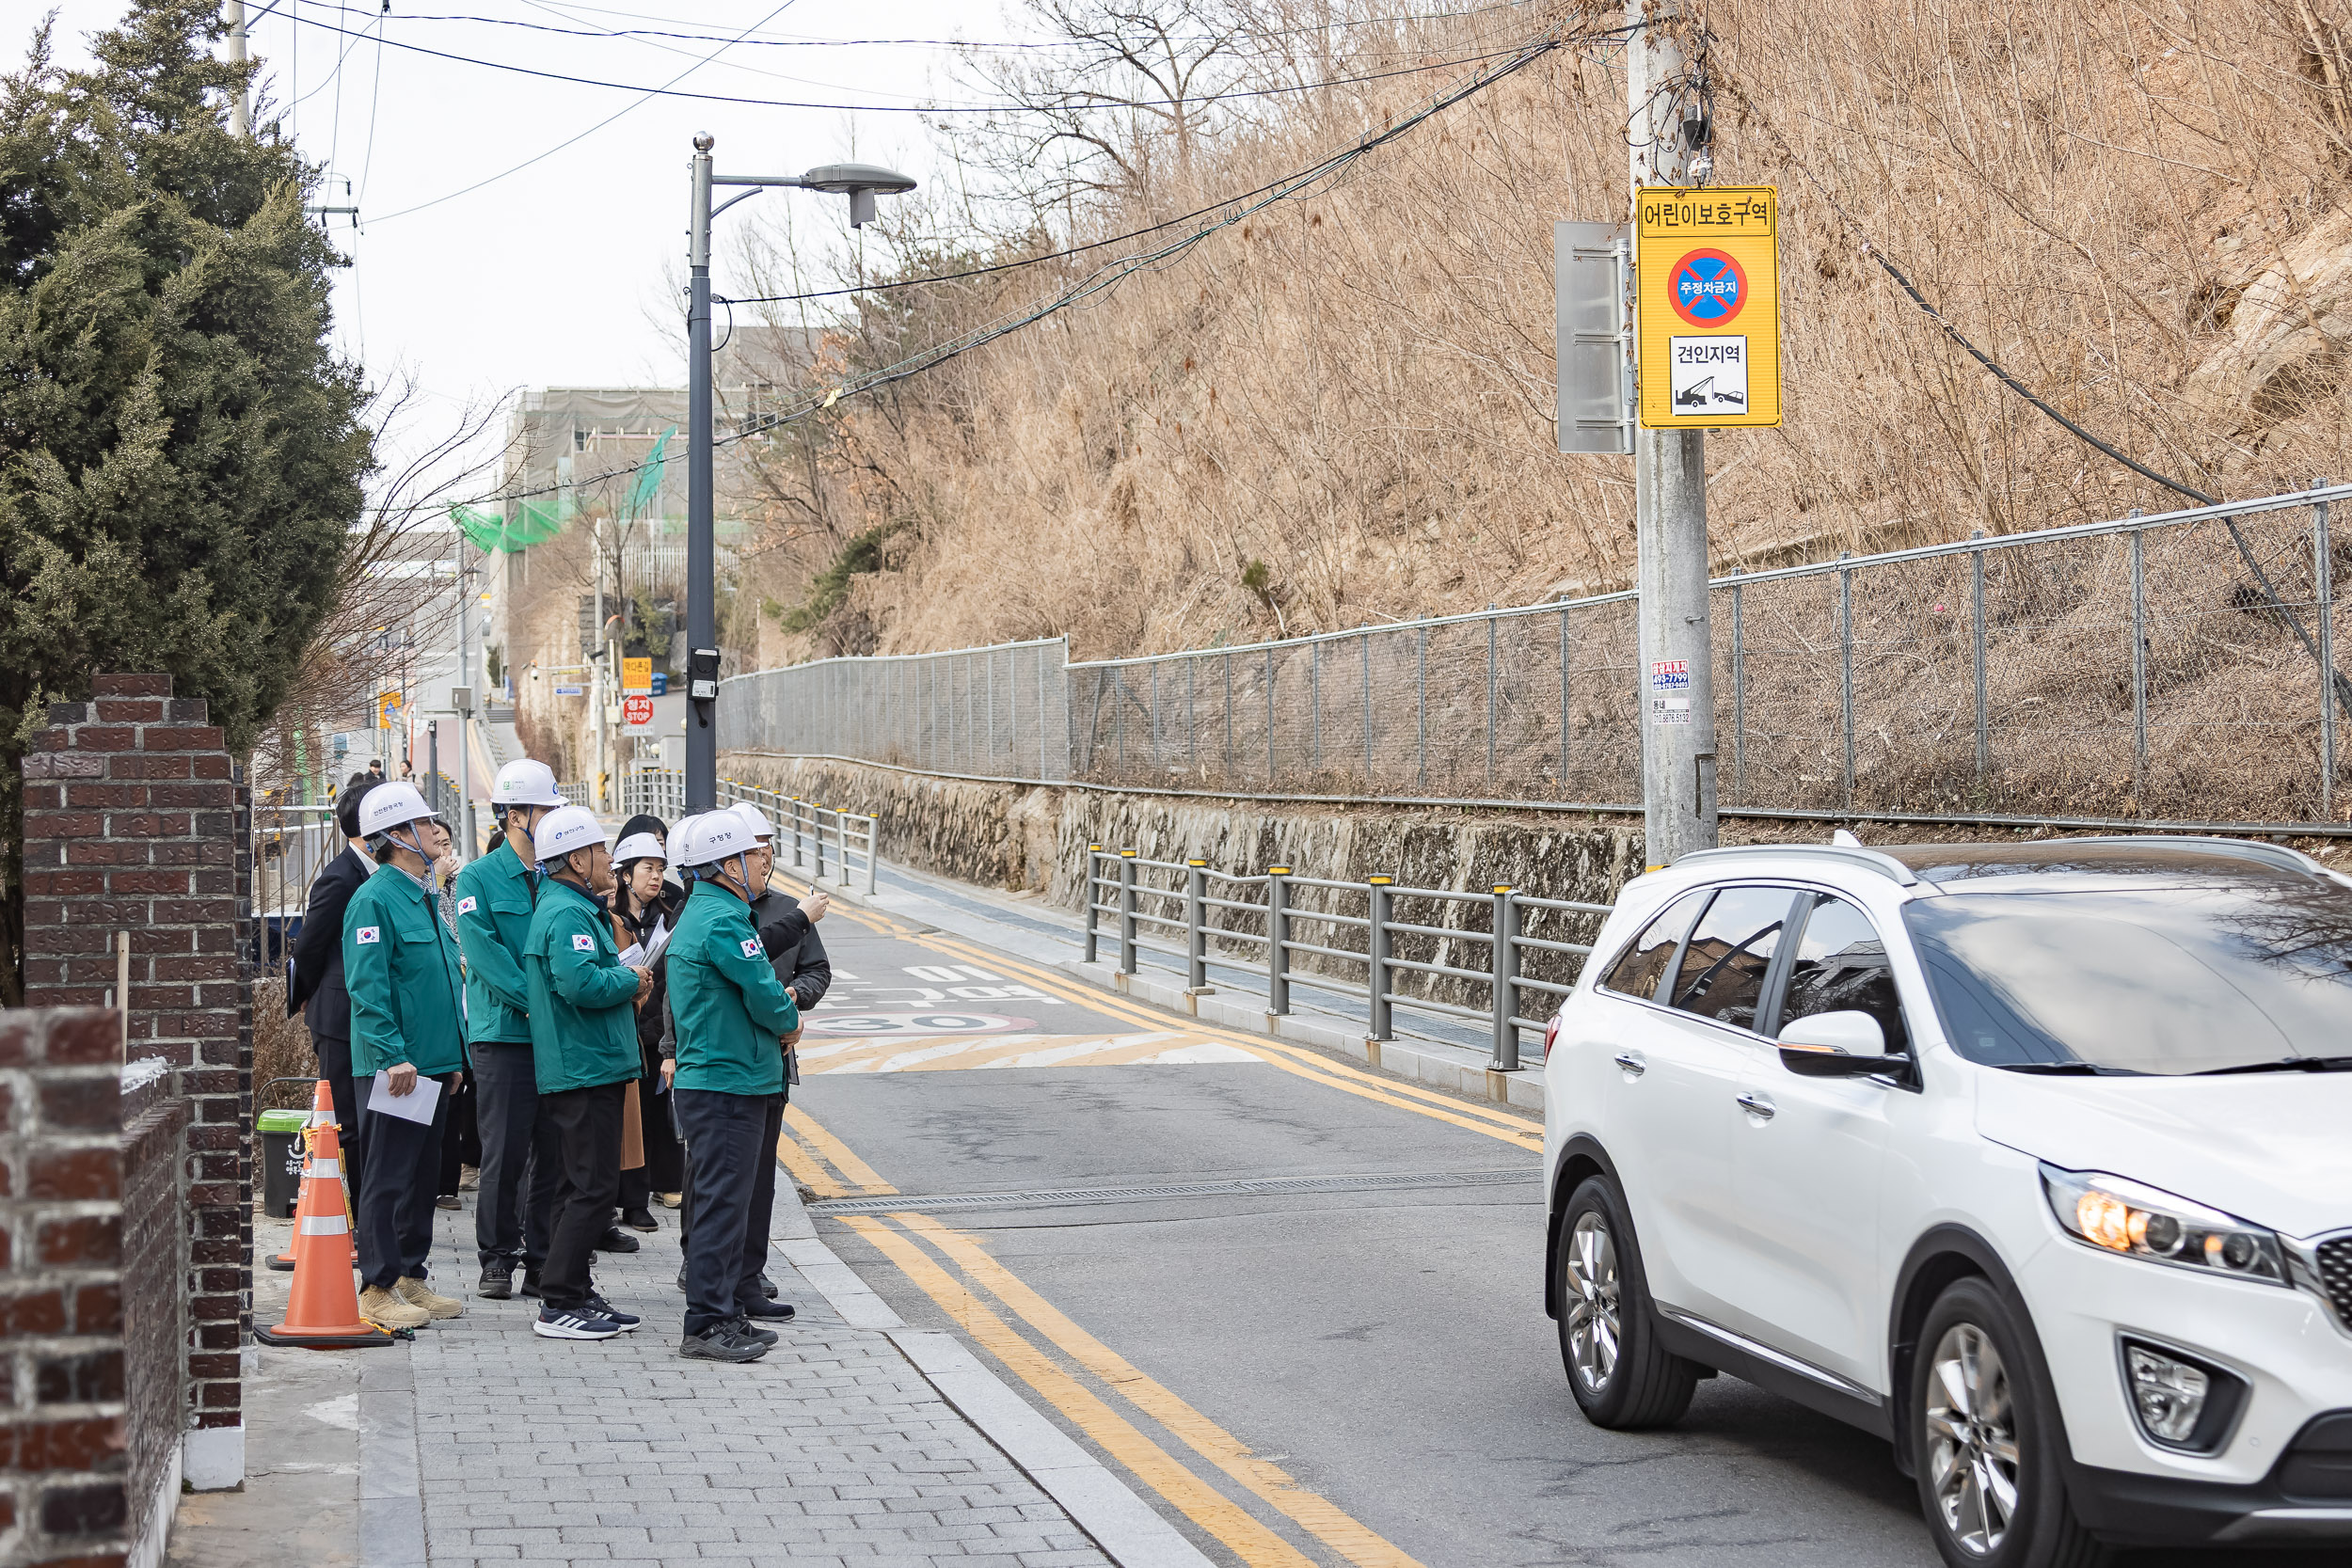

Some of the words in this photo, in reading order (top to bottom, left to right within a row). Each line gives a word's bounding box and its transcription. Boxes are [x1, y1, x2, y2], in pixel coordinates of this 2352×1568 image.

[1645, 202, 1768, 227] 어린이보호구역
[1680, 281, 1737, 294] 주정차금지
[1677, 345, 1740, 363] 견인지역
[628, 699, 649, 711] 정지
[627, 711, 649, 721] STOP
[709, 832, 732, 845] 구청장
[817, 1016, 988, 1031] 30
